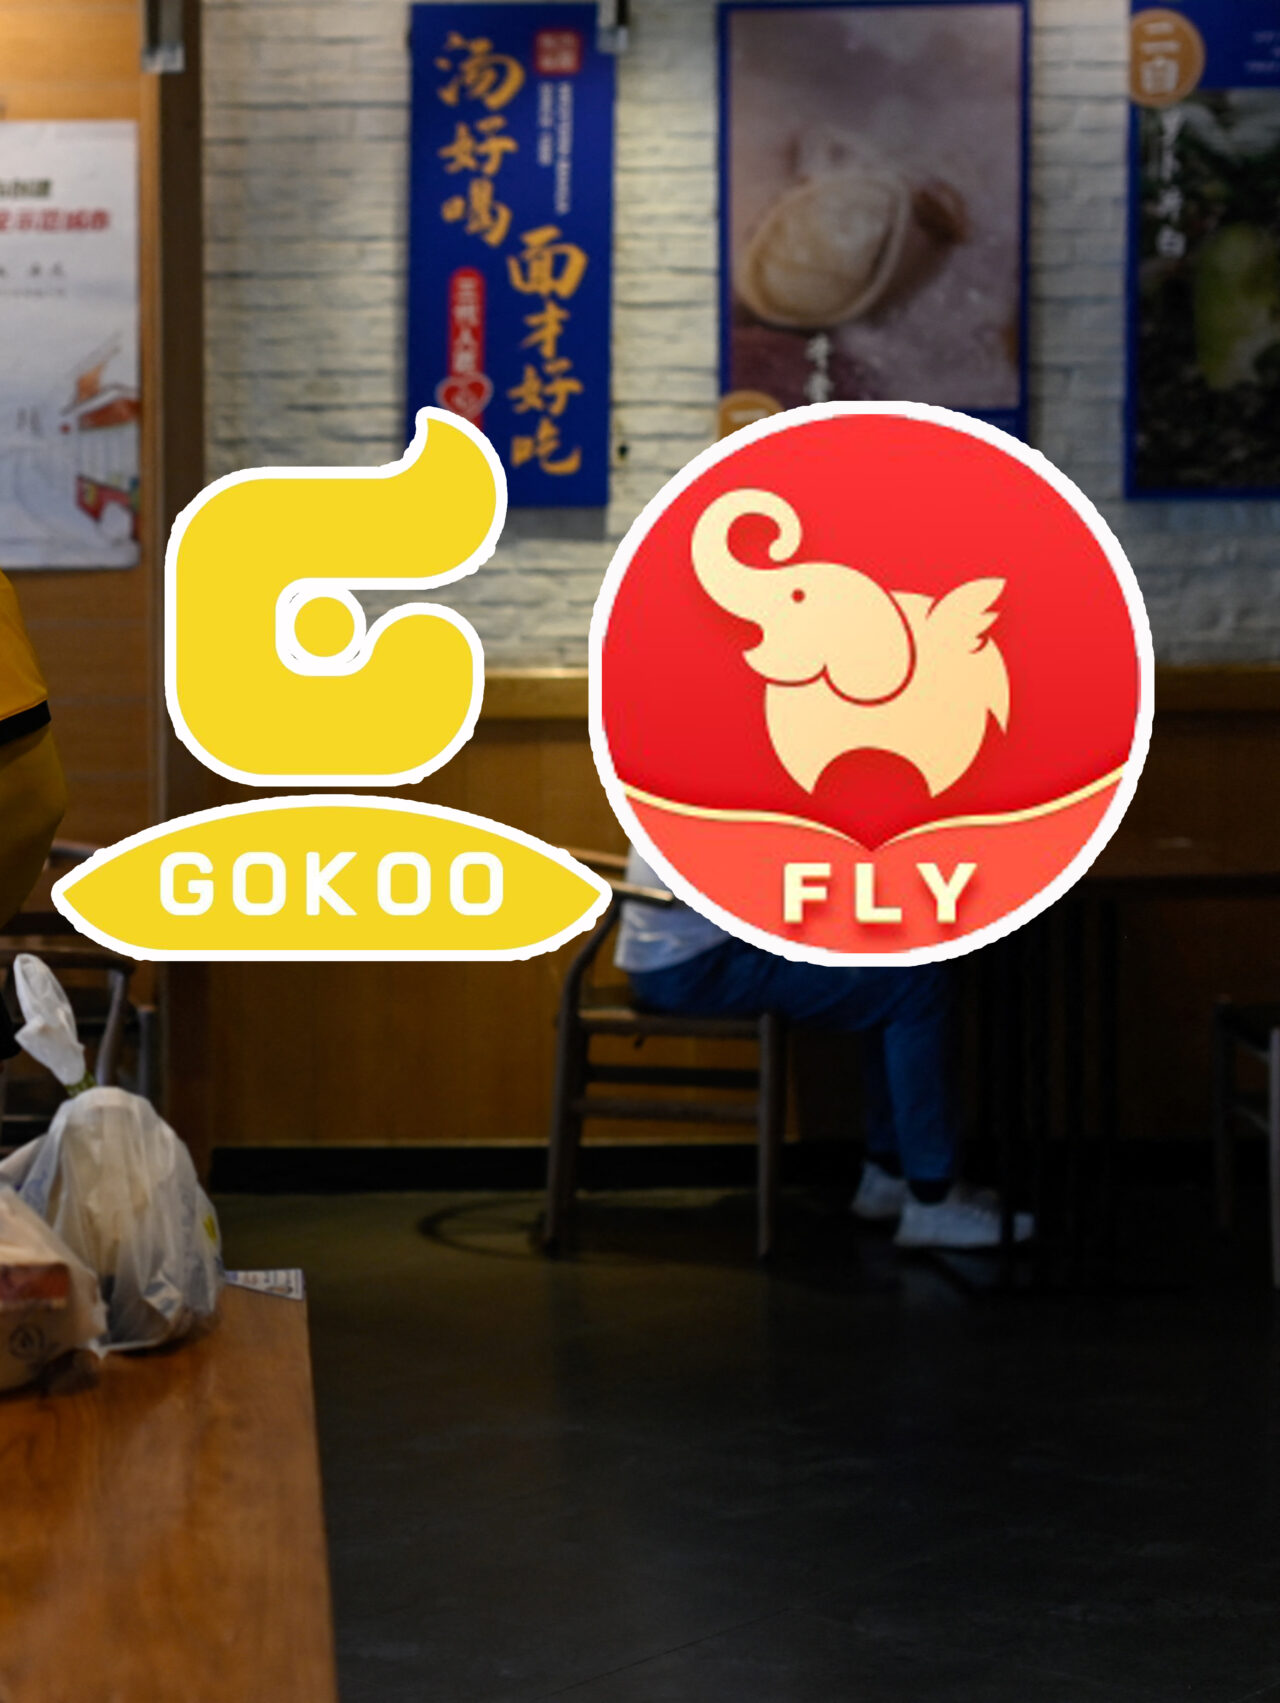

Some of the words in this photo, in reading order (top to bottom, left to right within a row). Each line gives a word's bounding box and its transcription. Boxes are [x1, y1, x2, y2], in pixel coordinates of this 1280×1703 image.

[434, 30, 525, 248] 汤好喝
[507, 225, 588, 475] 面才好吃
